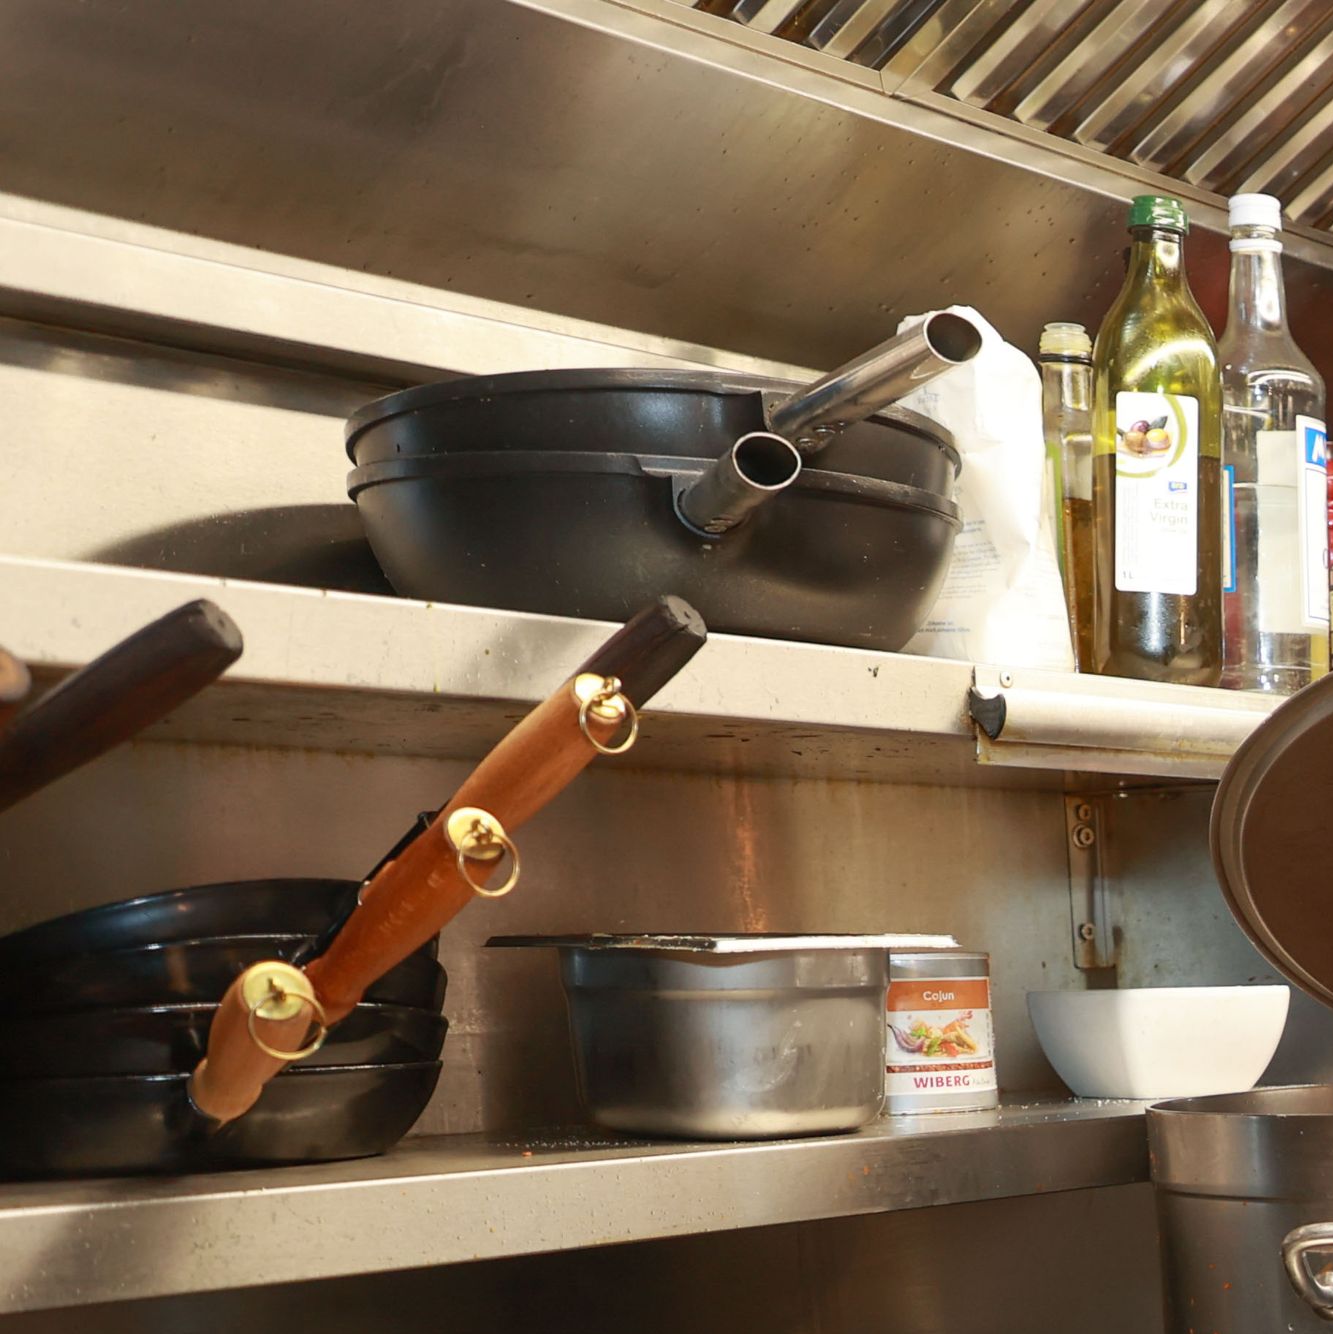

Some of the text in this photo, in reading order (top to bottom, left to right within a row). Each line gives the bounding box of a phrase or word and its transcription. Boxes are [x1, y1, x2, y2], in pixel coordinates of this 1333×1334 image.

[1154, 498, 1188, 511] Extra
[1150, 512, 1188, 526] Virgin
[923, 990, 955, 1002] Cajun
[913, 1075, 970, 1089] WIBERG
